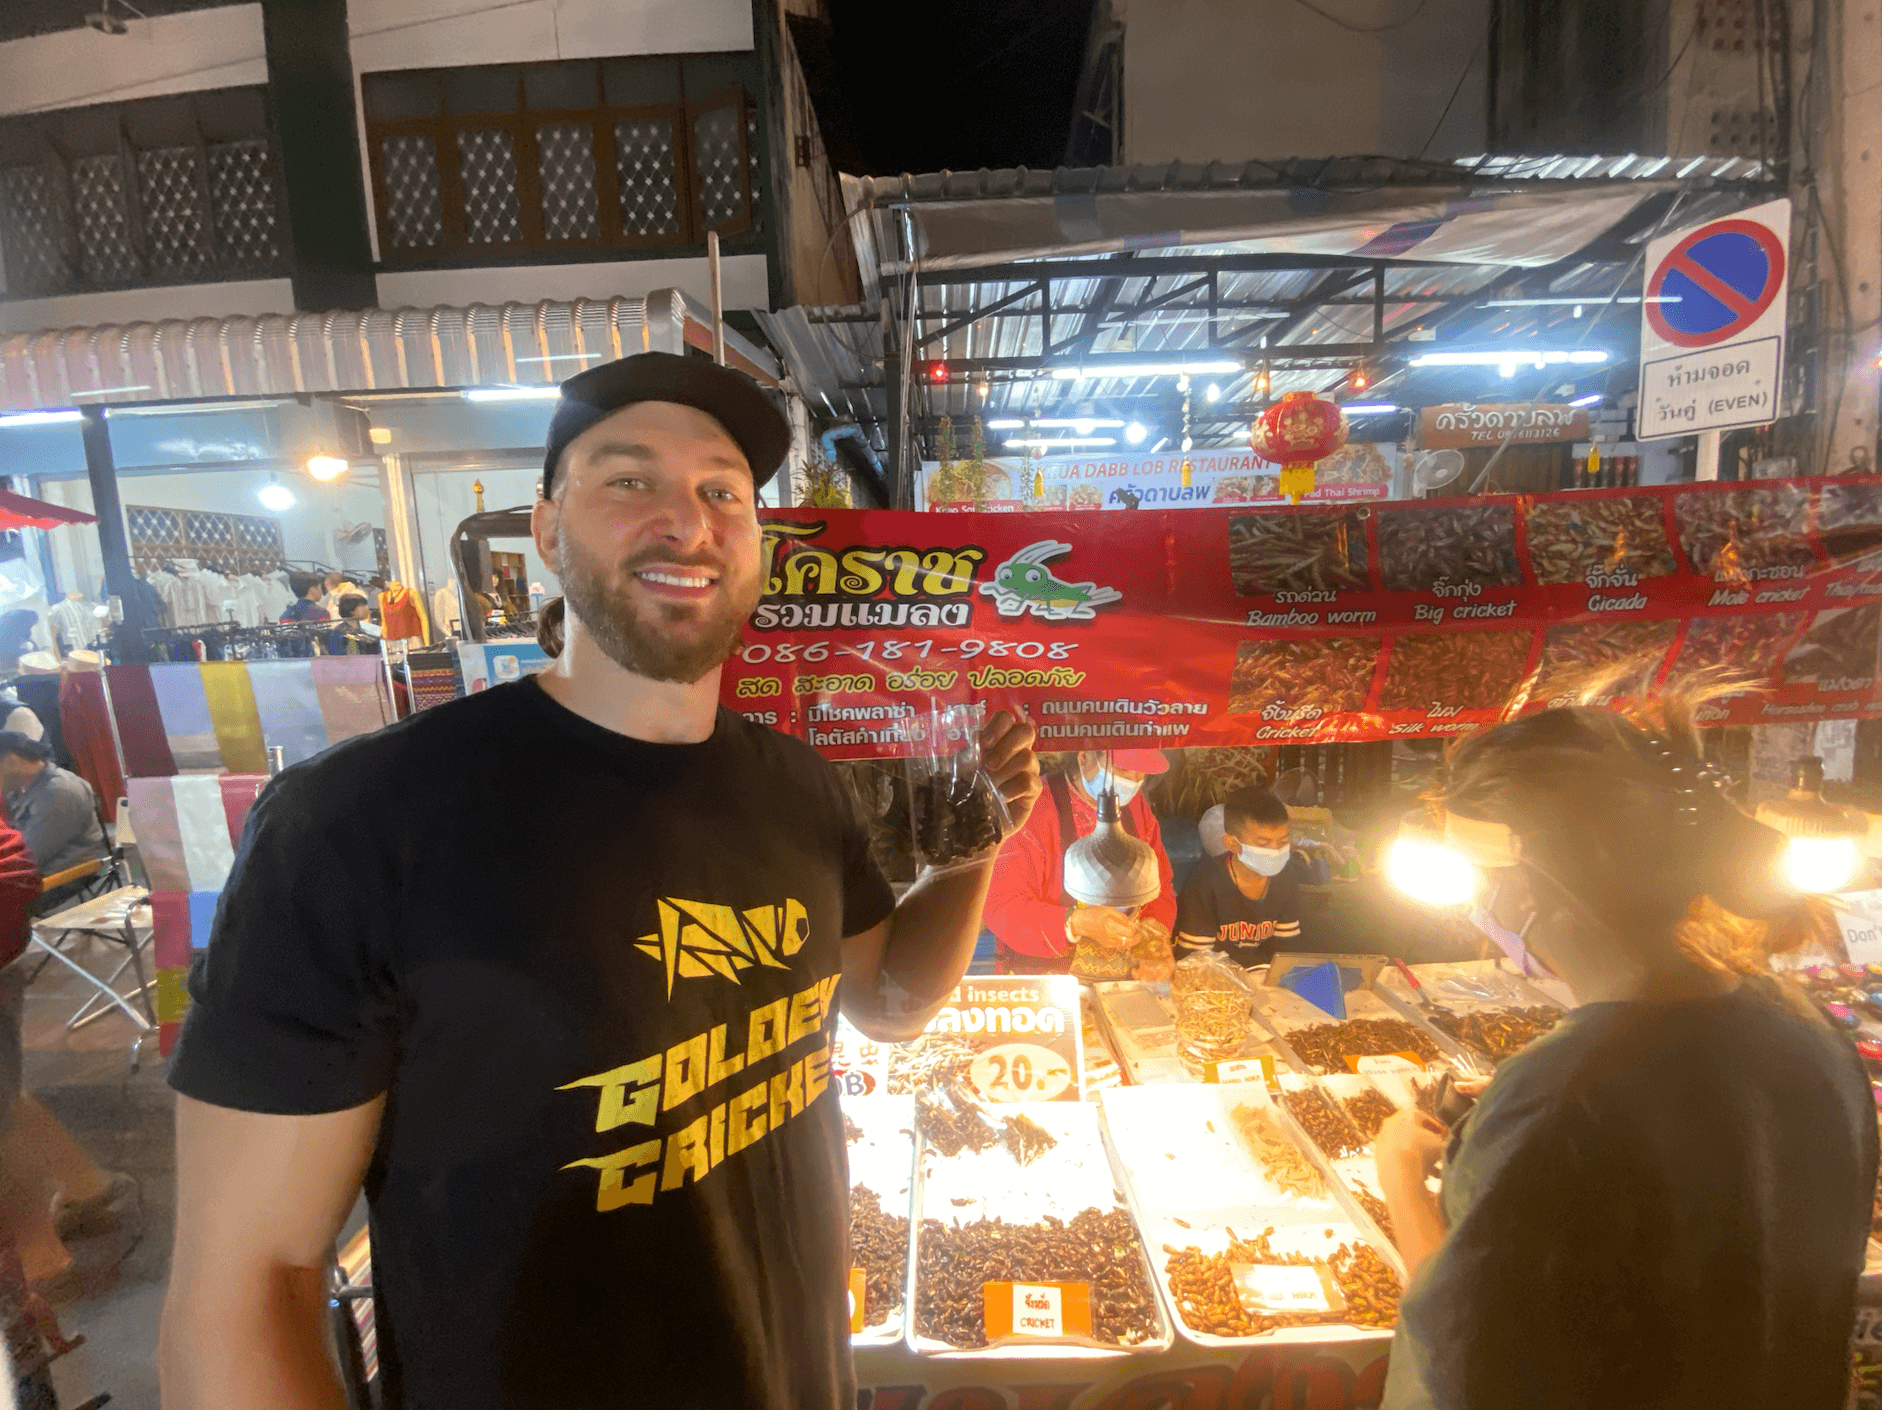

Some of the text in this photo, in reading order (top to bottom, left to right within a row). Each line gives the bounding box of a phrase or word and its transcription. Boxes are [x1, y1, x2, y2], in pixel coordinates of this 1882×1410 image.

[1667, 360, 1750, 388] ห้ามจอด
[1658, 391, 1768, 422] วันคู่ (EVEN)
[1471, 431, 1494, 441] TEL
[1084, 462, 1129, 479] DABB
[1132, 460, 1164, 476] LOB
[1168, 456, 1272, 475] RESTAURANT
[1325, 487, 1345, 498] Thai
[1347, 486, 1381, 498] Shrimp
[762, 525, 984, 596] โคราช
[1276, 586, 1338, 604] รถด่วน
[1588, 592, 1648, 612] Cicada
[755, 602, 970, 628] รวมแมลง
[1246, 609, 1377, 627] Bamboo worm
[1414, 600, 1517, 624] Big cricket
[743, 638, 1079, 664] 086-181-9808
[736, 664, 1087, 697] สด สะอาด อร่อย ปลอดภัย
[1041, 698, 1208, 715] ถนนคนเดินวัวลาย
[1256, 721, 1322, 739] Cricket
[1388, 722, 1425, 735] Silk
[1216, 921, 1276, 941] JUNIO
[968, 986, 1041, 1003] insects
[558, 1031, 831, 1212] CRICKE
[1020, 1317, 1055, 1329] CRICKET
